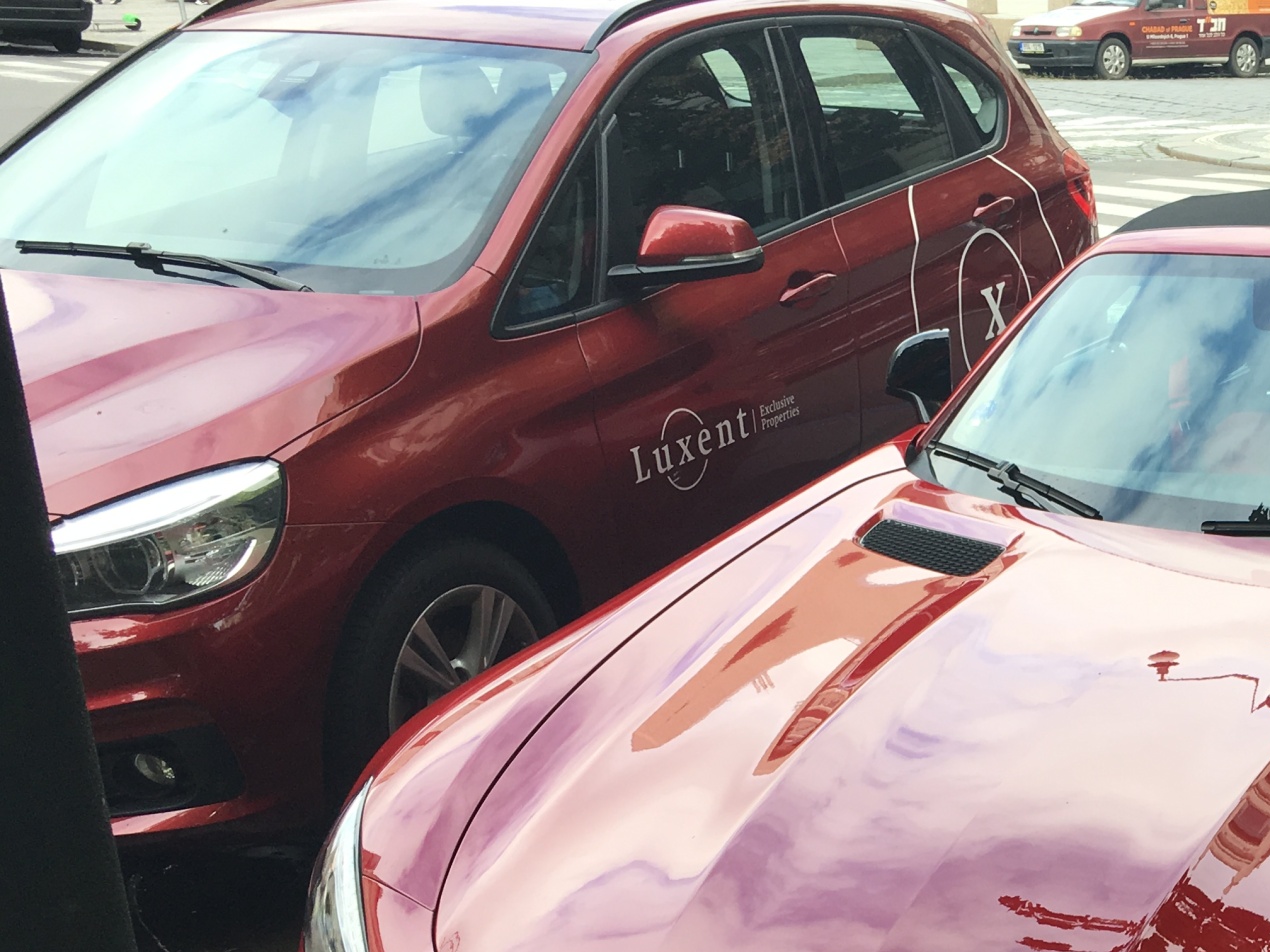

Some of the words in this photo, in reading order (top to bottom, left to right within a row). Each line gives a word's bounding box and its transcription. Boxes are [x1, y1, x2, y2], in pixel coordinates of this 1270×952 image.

[759, 395, 795, 418] Exclusive
[761, 405, 801, 431] Properties
[629, 408, 750, 484] Luxent
